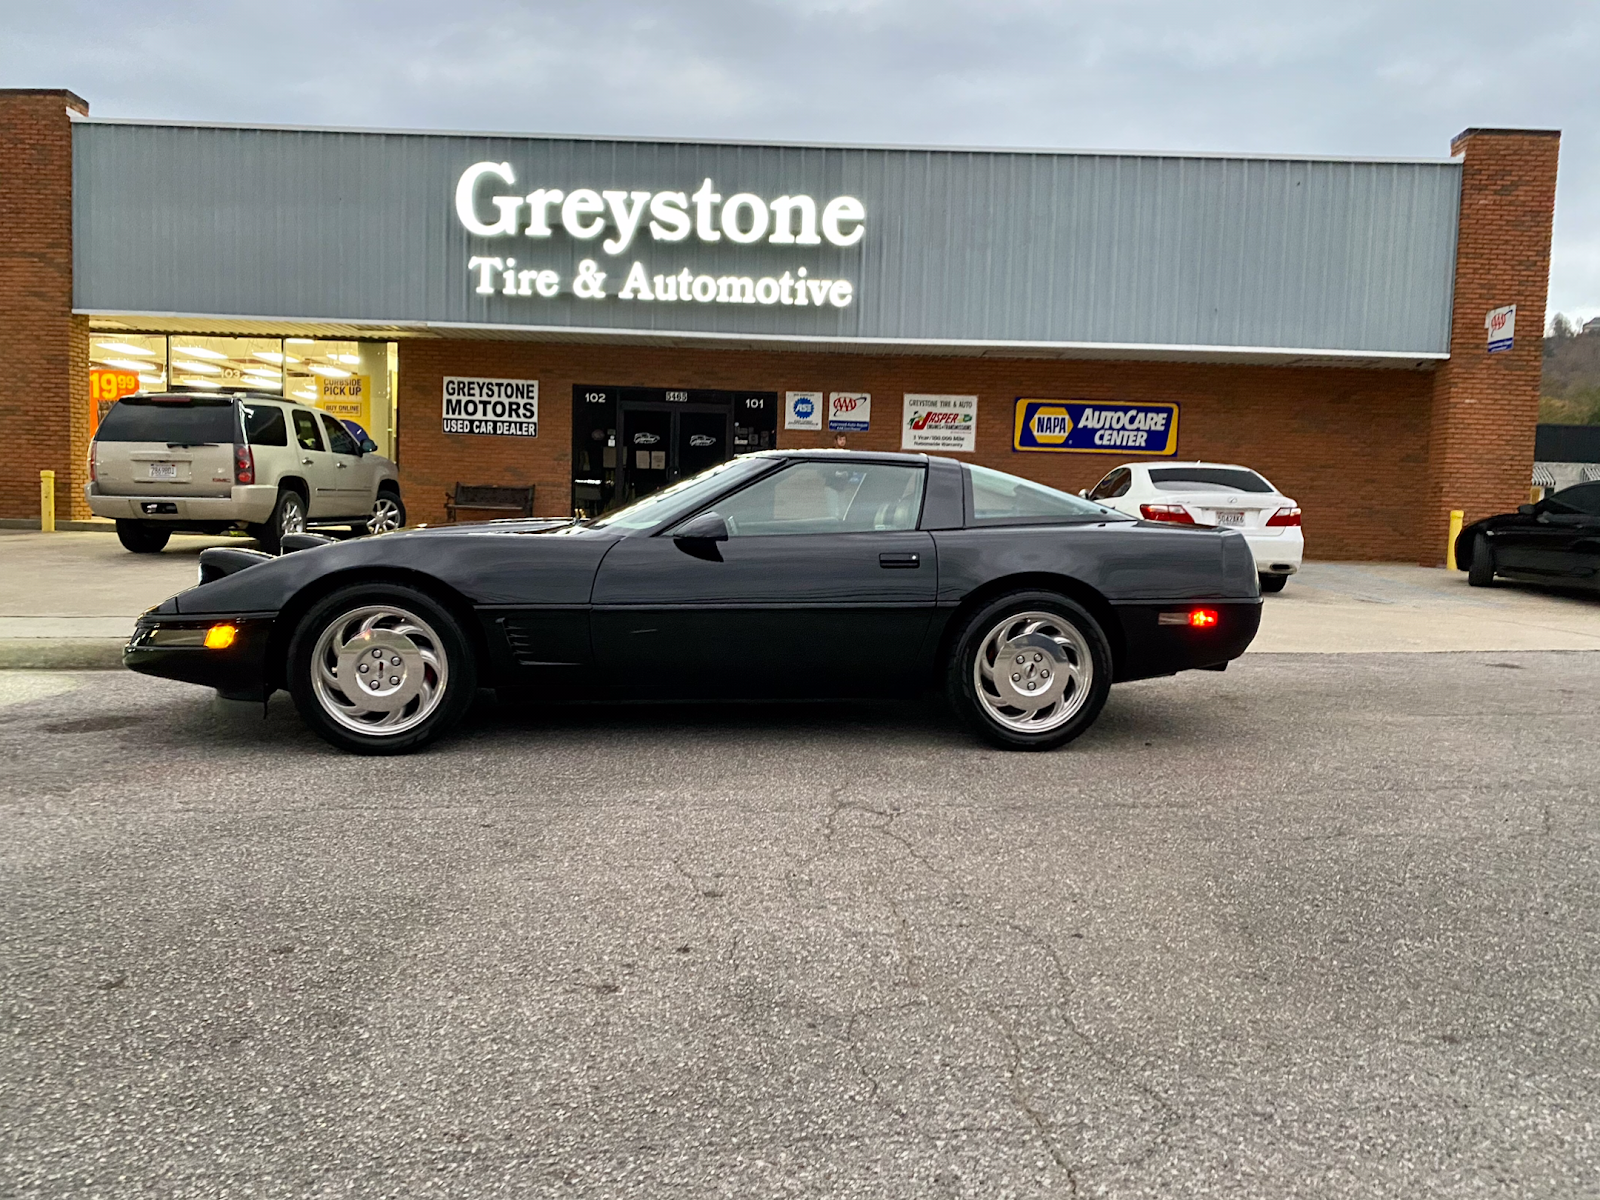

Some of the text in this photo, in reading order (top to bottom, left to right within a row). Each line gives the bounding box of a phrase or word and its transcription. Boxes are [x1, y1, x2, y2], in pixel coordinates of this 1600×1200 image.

[456, 161, 866, 255] Greystone
[468, 255, 853, 308] Tire & Automotive
[323, 379, 362, 387] CURBSIDE
[323, 386, 362, 396] PICK UP
[445, 380, 535, 400] GREYSTONE
[585, 393, 606, 403] 102
[745, 398, 764, 409] 101
[833, 397, 857, 412] AAA
[908, 399, 938, 408] GREYSTONE
[940, 400, 951, 408] TIRE
[959, 401, 972, 409] AUTO
[445, 399, 535, 419] MOTORS
[795, 404, 812, 412] ASE
[443, 420, 535, 436] USED CAR DEALER
[912, 411, 959, 430] JASPER
[1036, 416, 1067, 434] NAPA
[1094, 429, 1148, 447] CENTER
